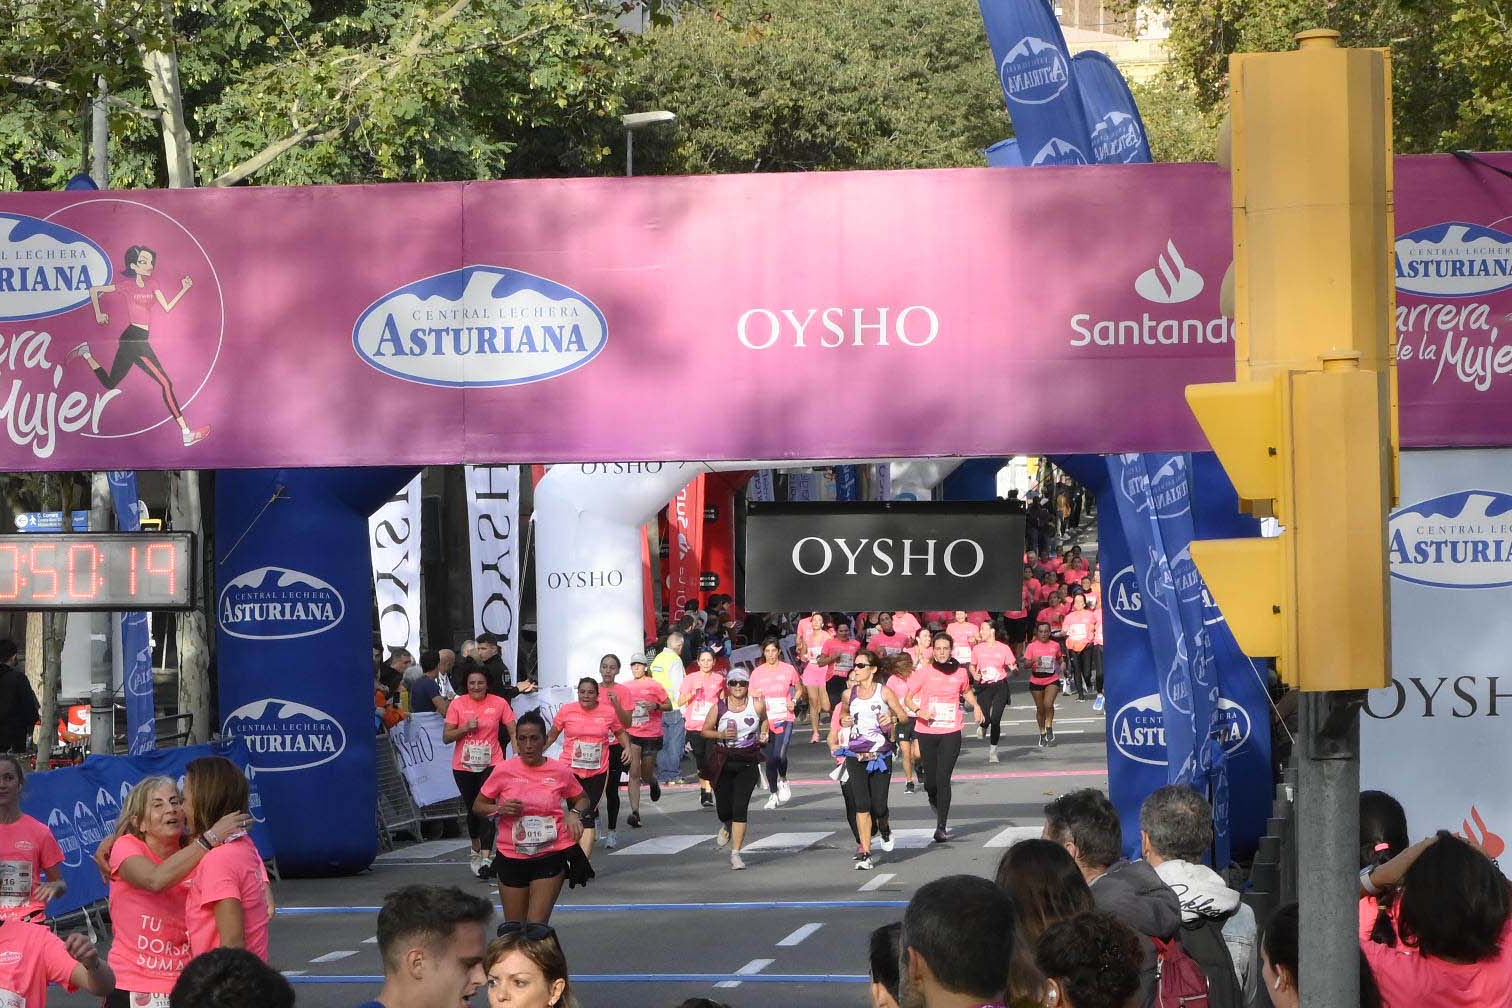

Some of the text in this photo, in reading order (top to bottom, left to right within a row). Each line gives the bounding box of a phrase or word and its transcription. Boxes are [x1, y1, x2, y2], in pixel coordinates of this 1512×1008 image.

[15, 248, 88, 260] LECHERA
[1396, 250, 1512, 279] ASTURIAN
[1408, 247, 1512, 256] CENTRAL LECHER
[411, 306, 580, 321] CENTRAL LECHERA
[737, 305, 940, 349] OYSHO
[1396, 302, 1491, 333] arrera
[372, 313, 589, 359] ASTURIANA
[1070, 313, 1237, 347] Santand
[1419, 326, 1512, 392] la Muje
[1416, 525, 1484, 535] CENTRAL
[791, 536, 985, 578] OYSHO
[547, 570, 624, 590] OYSHO
[235, 591, 331, 600] CENTRAL LECHERA
[223, 597, 336, 624] ASTURIANA
[237, 723, 332, 732] CENTRAL LECHERA
[1118, 717, 1168, 746] ASTU
[1135, 716, 1164, 724] CENT
[226, 727, 337, 754] TURIANA
[141, 914, 163, 932] TU
